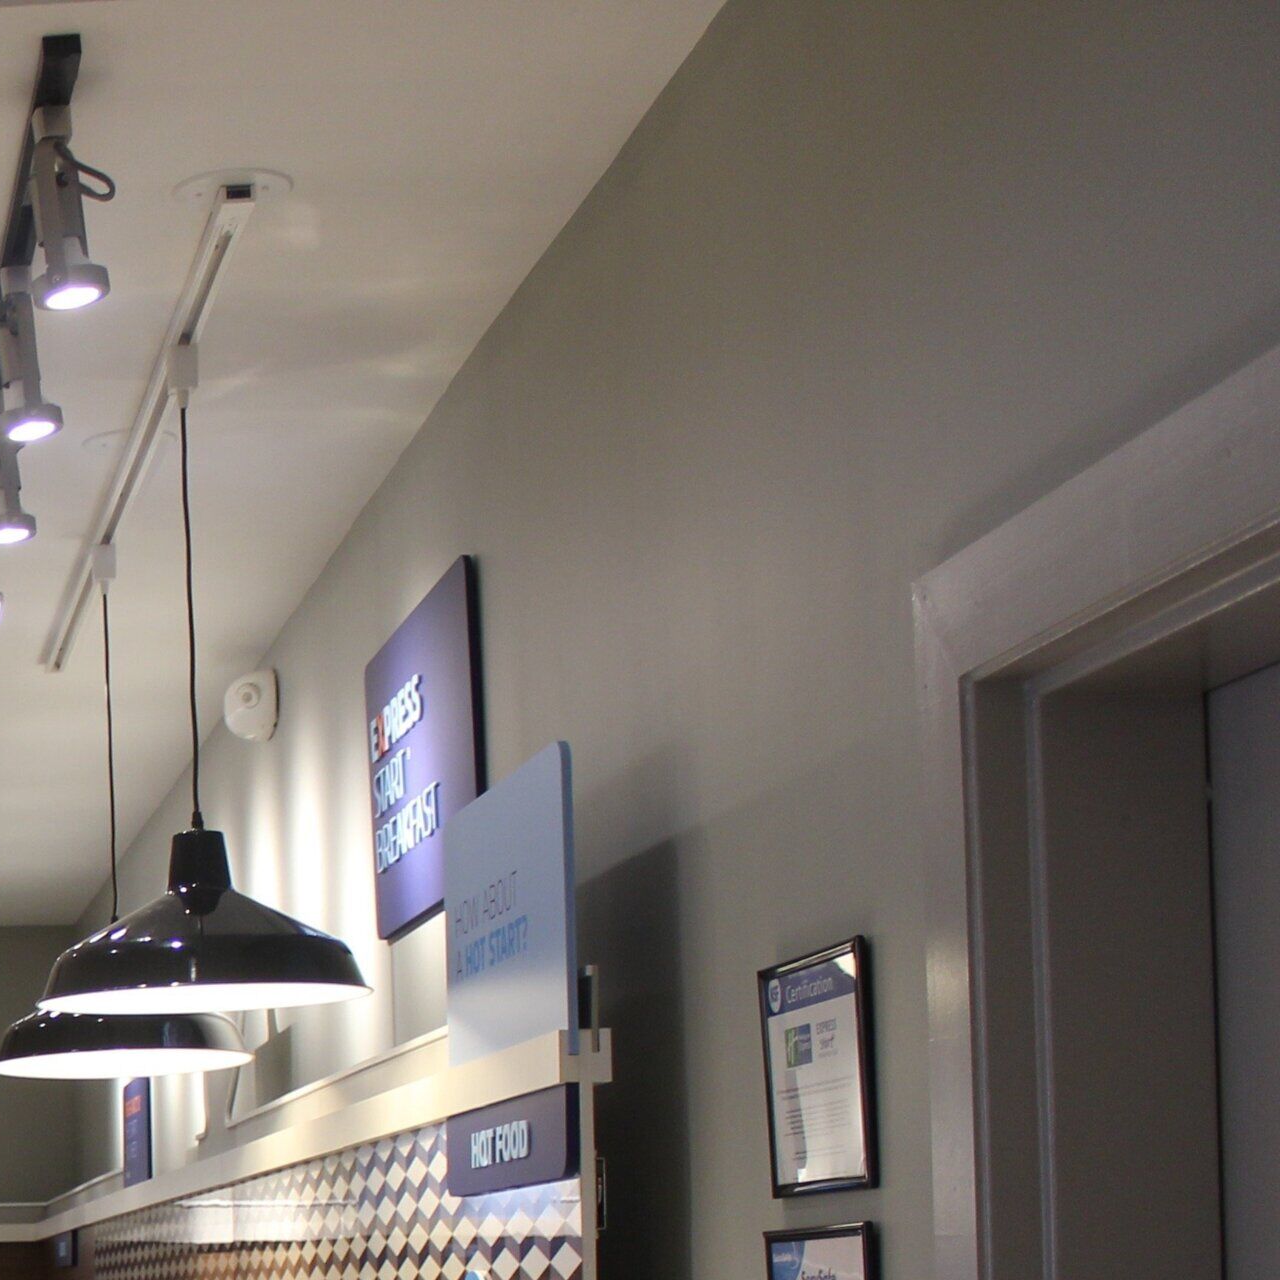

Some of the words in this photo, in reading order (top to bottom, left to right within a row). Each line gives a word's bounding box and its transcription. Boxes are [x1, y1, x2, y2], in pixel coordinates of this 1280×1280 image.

[370, 674, 422, 764] EXPRESS
[376, 781, 440, 874] BREAKFAST
[483, 870, 517, 920] ABOUT
[465, 936, 486, 977] HOT
[489, 914, 527, 967] START?
[470, 1127, 495, 1169] HOT
[495, 1119, 529, 1164] FOOD
